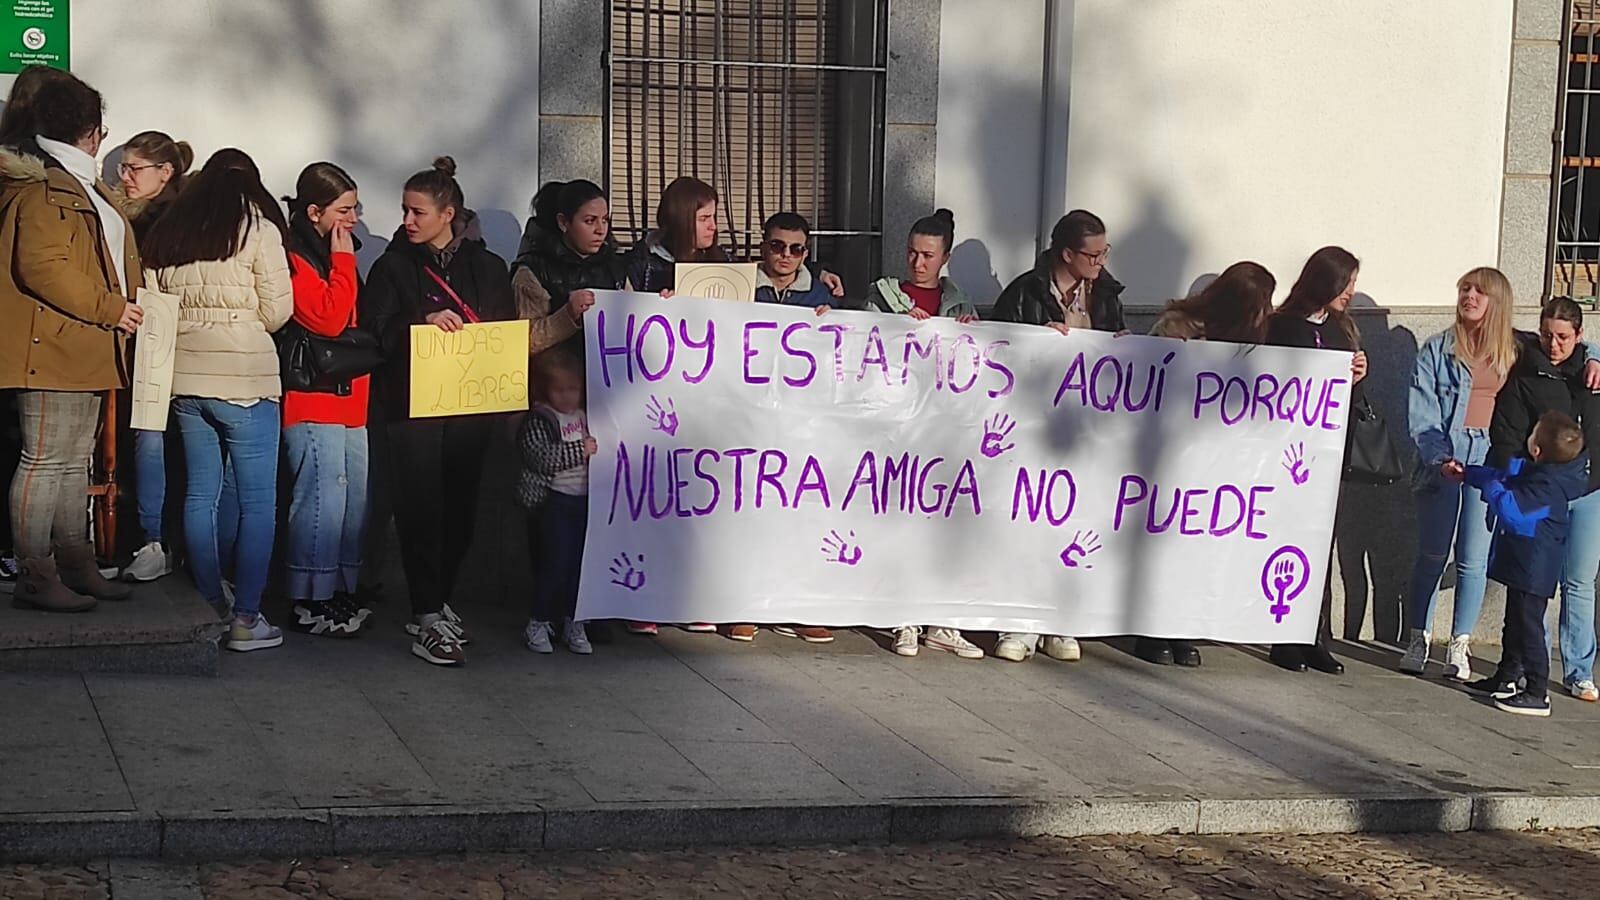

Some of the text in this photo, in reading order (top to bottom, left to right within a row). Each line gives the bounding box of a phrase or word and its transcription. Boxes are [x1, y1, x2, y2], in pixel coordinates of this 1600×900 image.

[416, 326, 505, 360] UNIDAS
[430, 369, 527, 412] LIBRES
[457, 358, 475, 384] Y
[598, 310, 1348, 431] HOY ESTAMOS AQUÍ PORQUE
[608, 441, 1276, 540] NUESTRA AMIGA NO PUEDE
